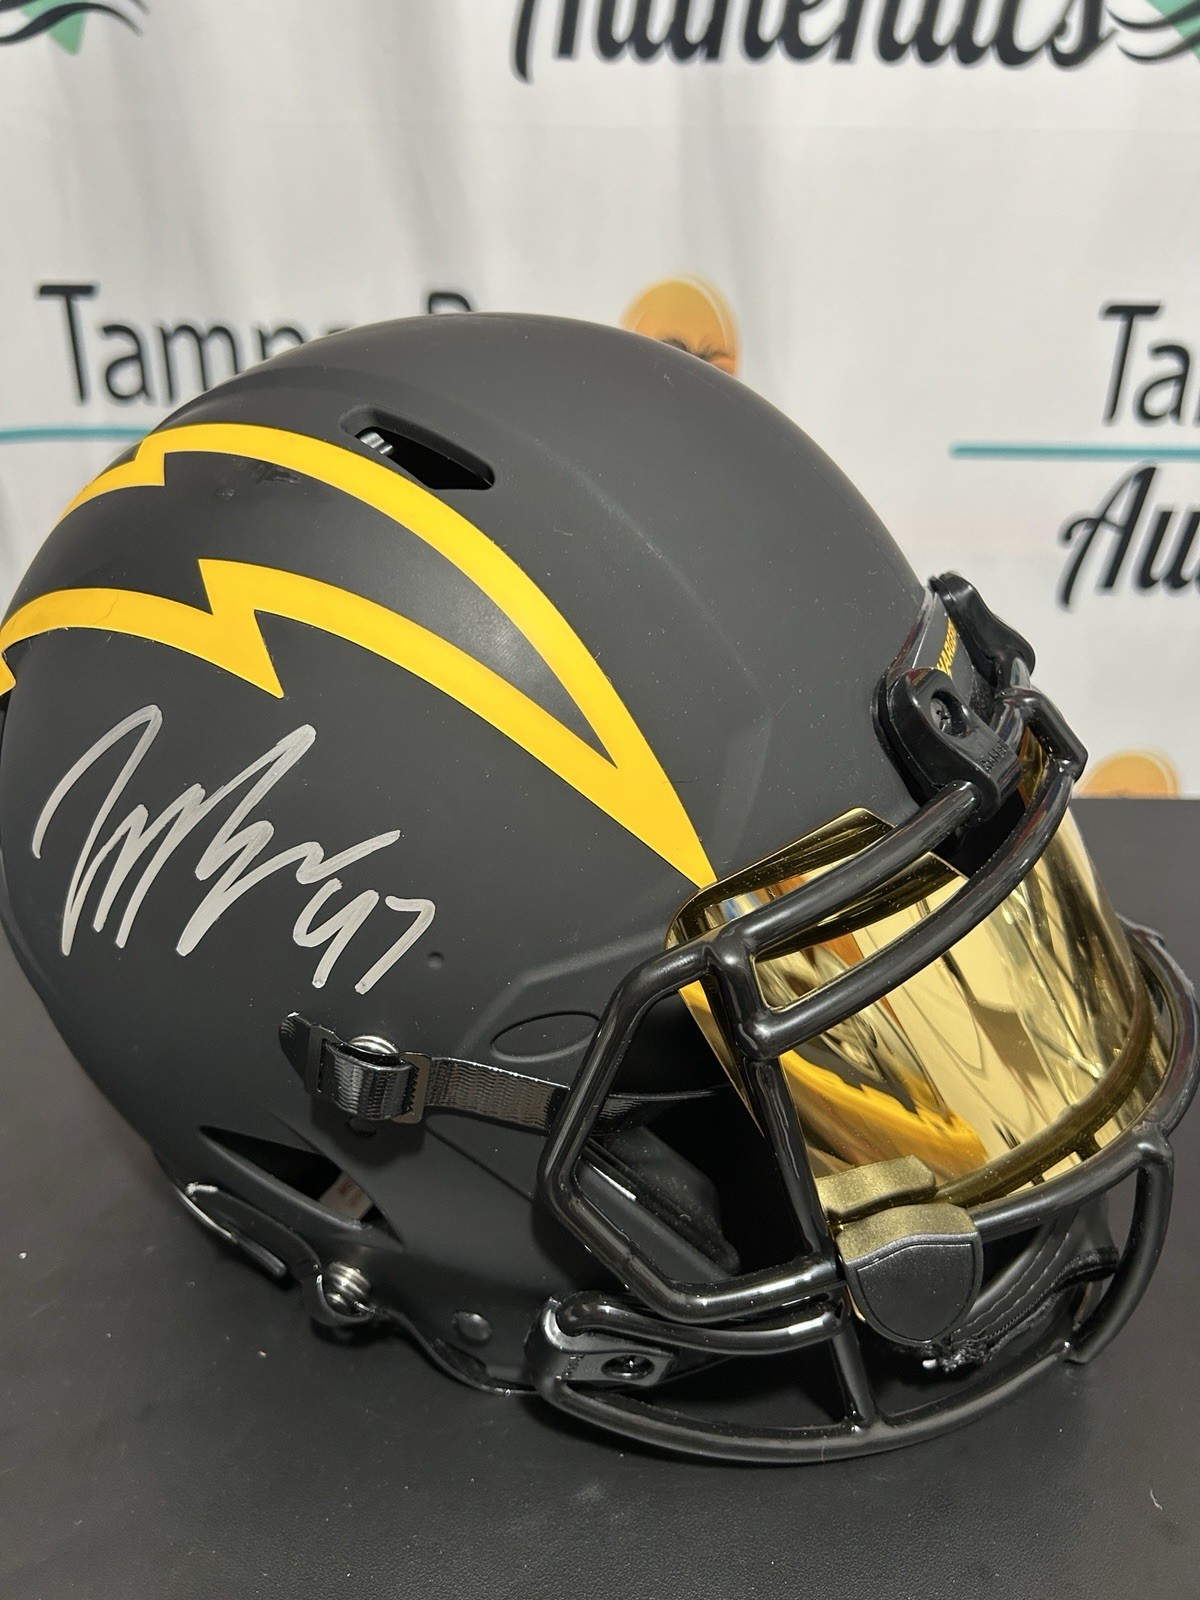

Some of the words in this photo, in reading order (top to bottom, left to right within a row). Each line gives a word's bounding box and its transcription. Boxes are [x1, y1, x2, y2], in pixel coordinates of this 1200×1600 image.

[38, 284, 358, 403] Tam
[1101, 303, 1200, 420] Ta
[1058, 465, 1200, 606] Au
